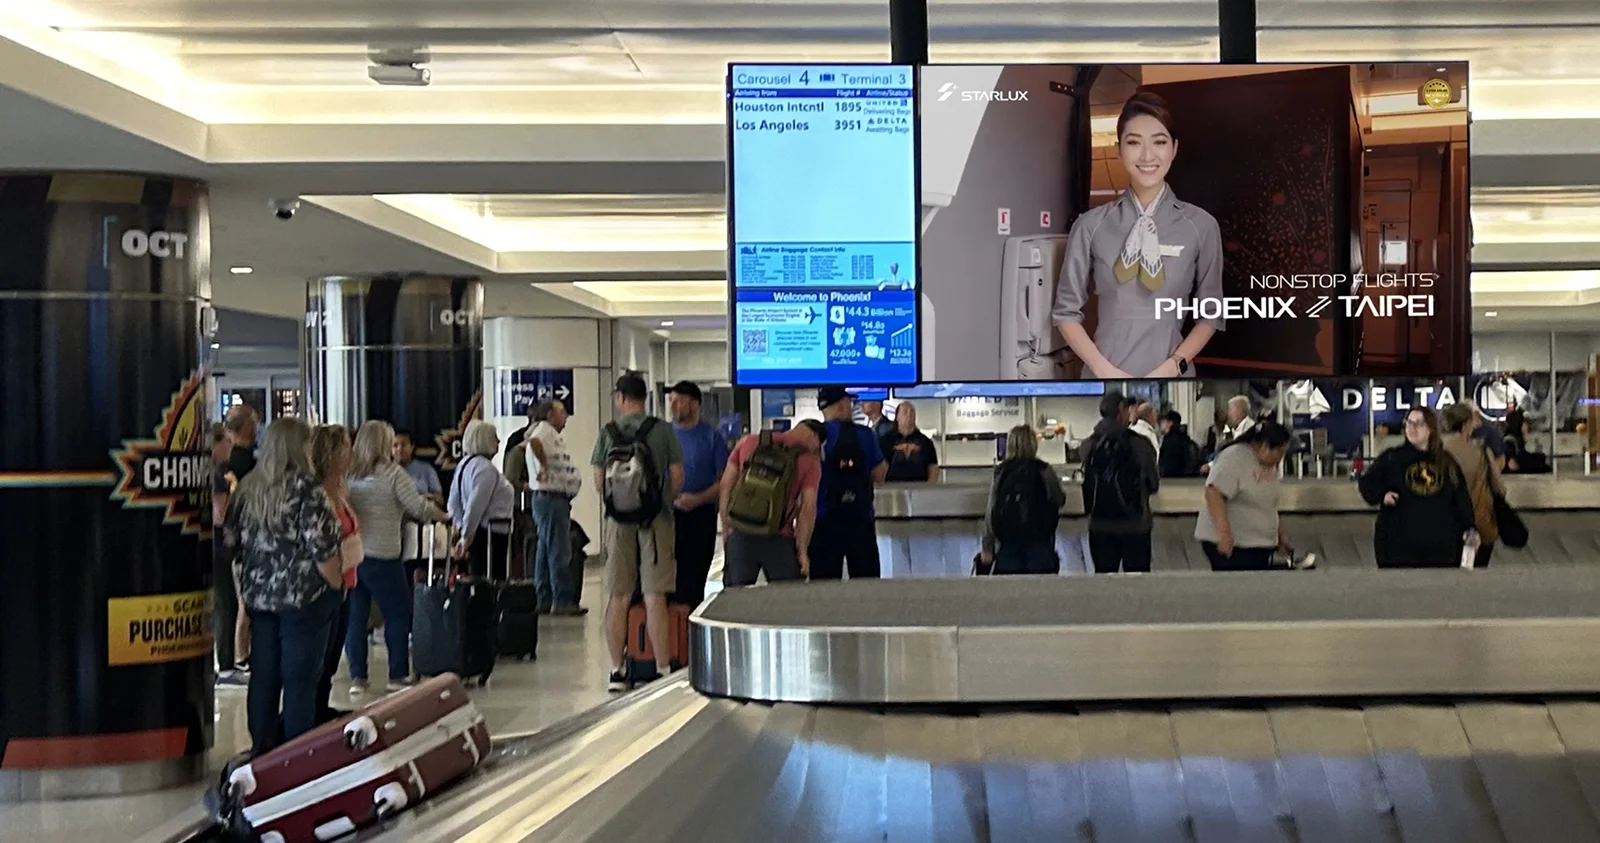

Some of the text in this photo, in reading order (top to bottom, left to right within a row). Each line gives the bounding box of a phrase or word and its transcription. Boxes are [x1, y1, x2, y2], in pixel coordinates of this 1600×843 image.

[737, 69, 810, 86] Carousel 4
[841, 73, 907, 85] Terminal 3
[961, 90, 1029, 102] STARLUX
[735, 101, 862, 112] Houston Intcntl 1895
[736, 119, 861, 133] Los Angeles 3951
[877, 117, 908, 125] DELTA
[121, 229, 188, 259] OCT
[1250, 272, 1434, 290] NONSTOP FLIGHTS
[773, 291, 871, 303] Welcome to Phoenix!
[1154, 294, 1435, 320] PHOENIX TAIPEI
[514, 394, 534, 406] Pay
[1342, 386, 1456, 411] DELTA
[991, 407, 1019, 417] Service
